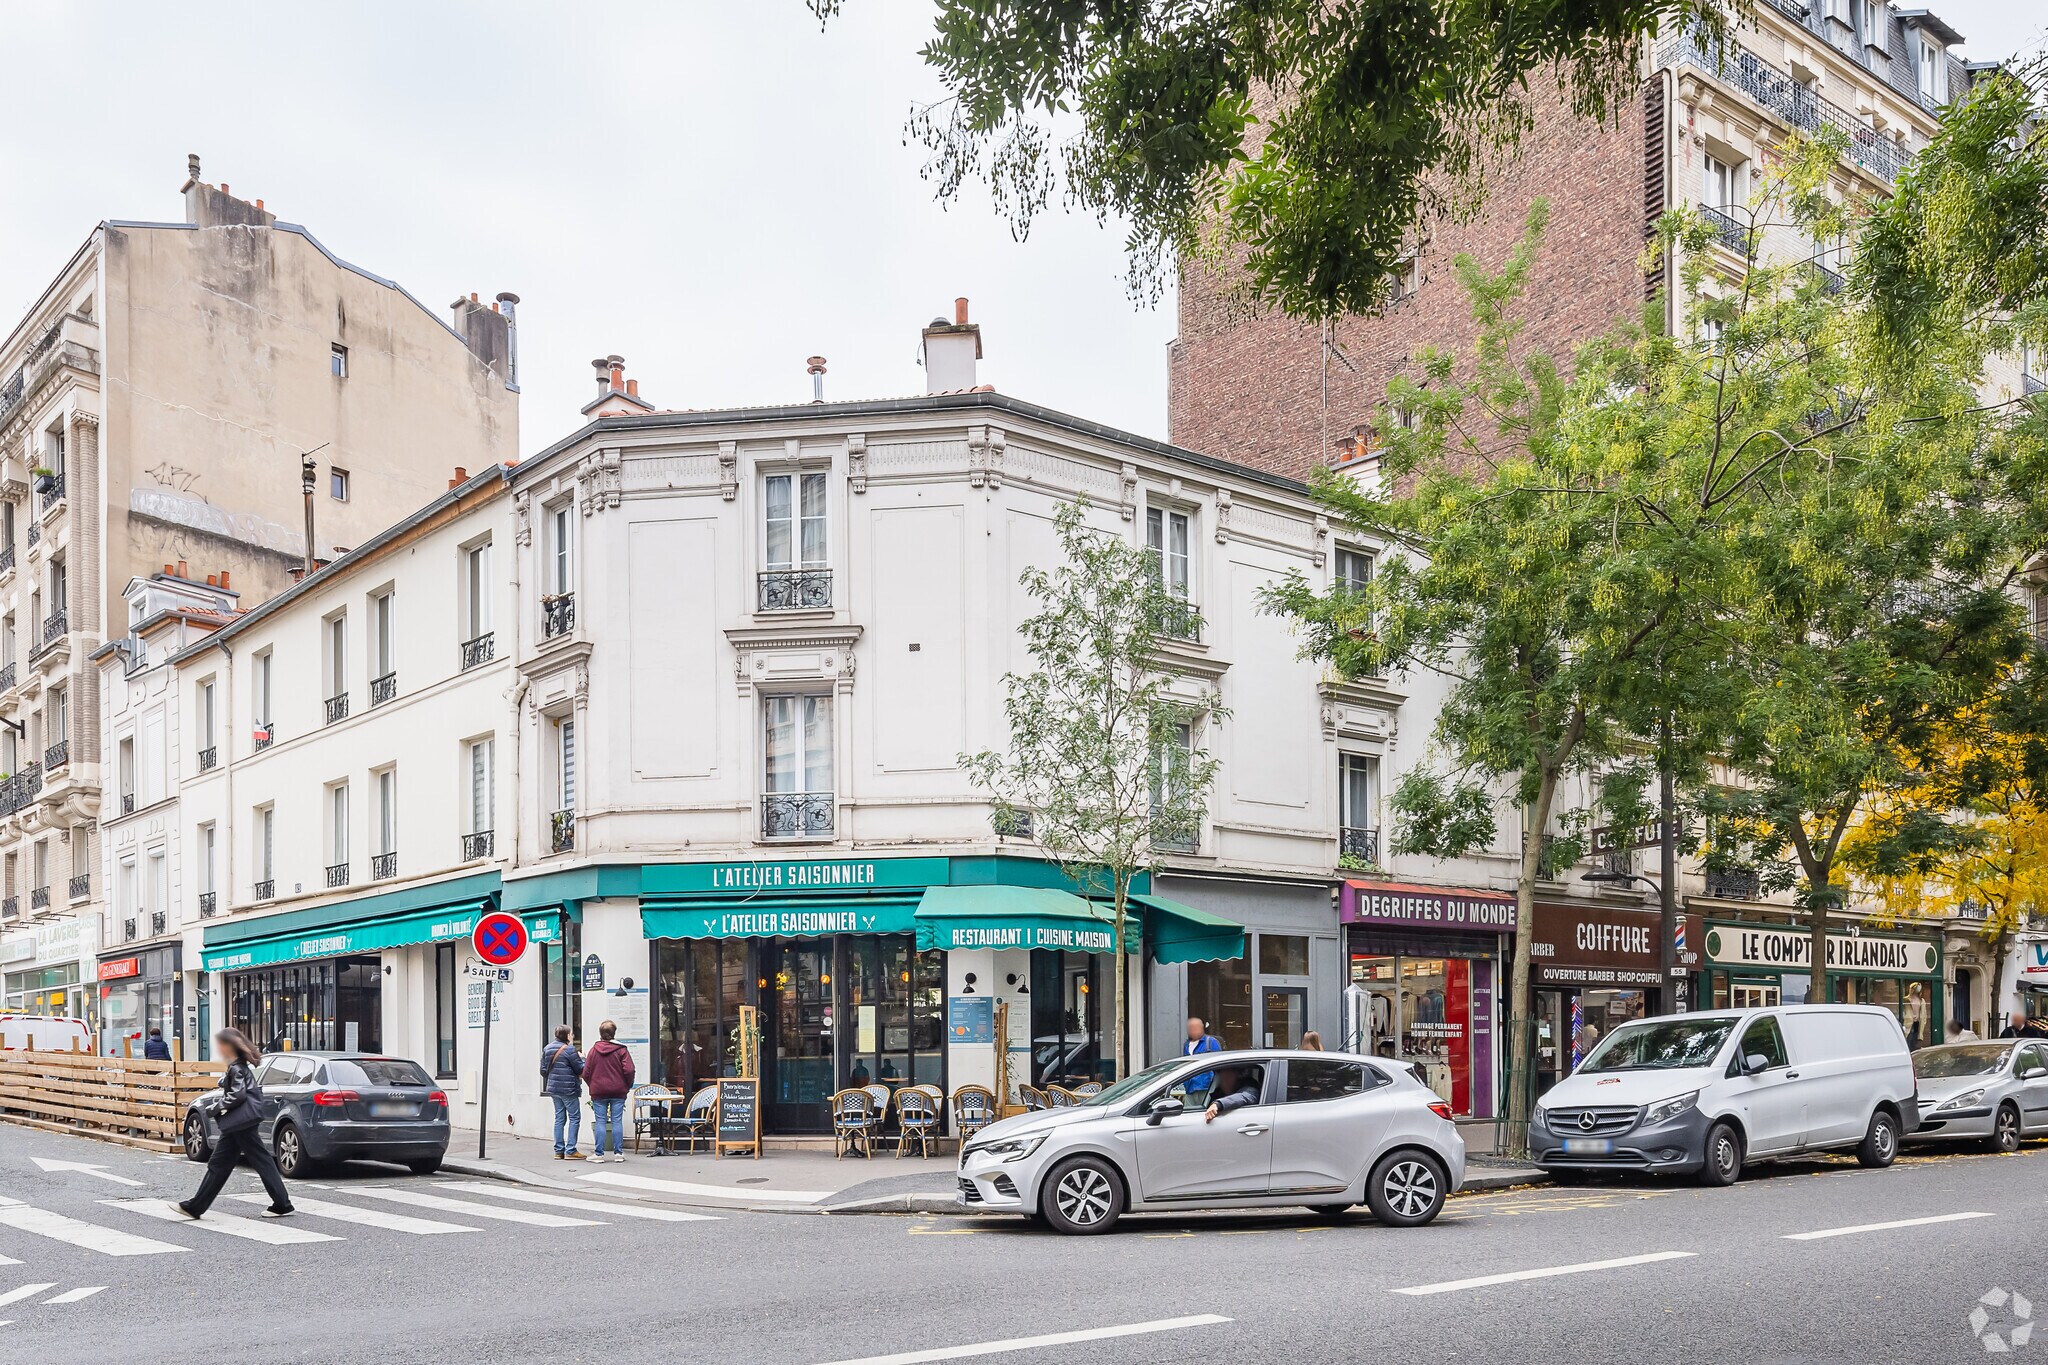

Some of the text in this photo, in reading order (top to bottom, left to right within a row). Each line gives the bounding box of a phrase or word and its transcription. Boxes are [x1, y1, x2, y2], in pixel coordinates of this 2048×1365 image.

[713, 864, 874, 888] L'ATELIER SAISONNIER
[1361, 894, 1516, 926] DEGRIFFES DU MONDE
[38, 929, 47, 946] LA
[49, 922, 80, 944] LAVERIE
[722, 912, 857, 934] L'ATELIER SAISONNIER
[953, 928, 1112, 949] RESTAURANT CUISINE MAISON
[1576, 922, 1651, 954] COIFFURE
[38, 950, 47, 961] DU
[48, 944, 79, 960] QUARTIER
[1742, 932, 1907, 969] LE COMPTR IRLANDAIS
[471, 967, 497, 978] SAUF
[1543, 968, 1587, 981] OUVERTURE
[1588, 971, 1615, 982] BARBER
[1617, 972, 1635, 983] SHOP
